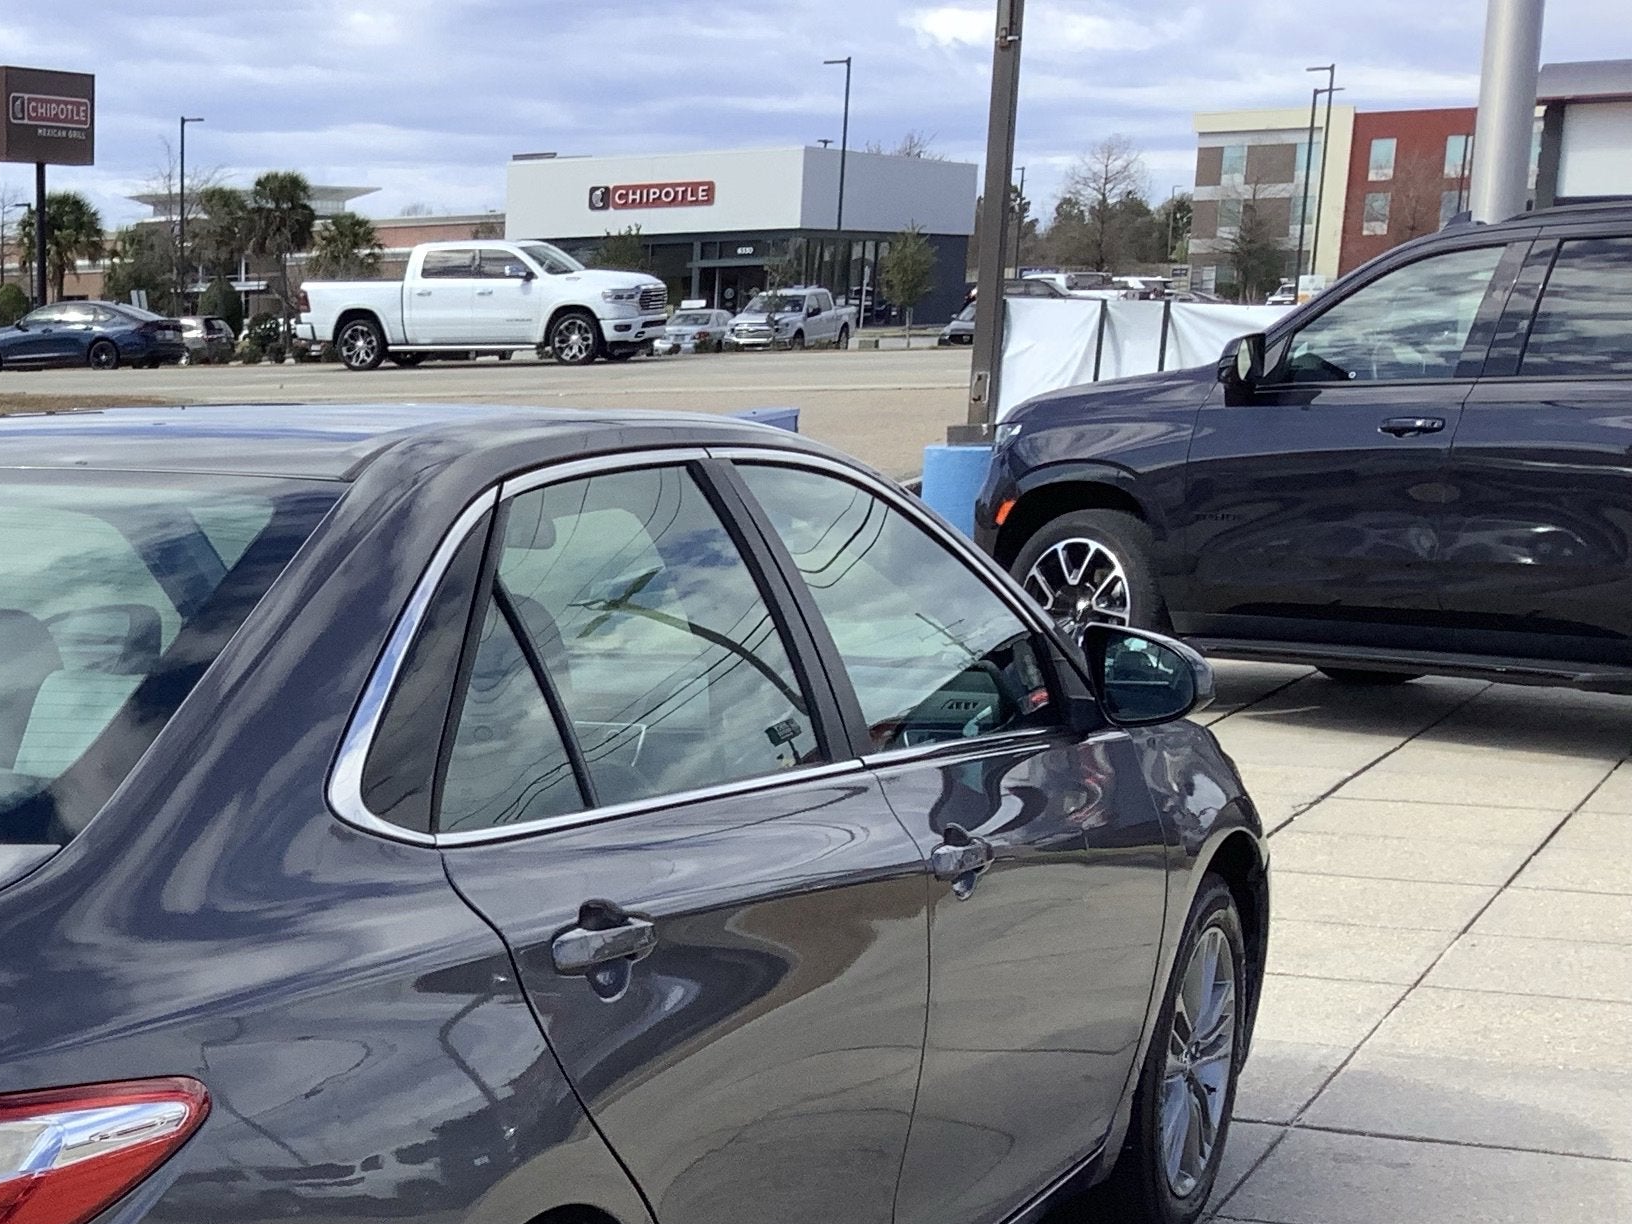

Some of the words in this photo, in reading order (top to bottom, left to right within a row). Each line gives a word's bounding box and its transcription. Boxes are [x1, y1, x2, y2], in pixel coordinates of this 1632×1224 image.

[29, 101, 86, 120] CHIPOTLE
[37, 128, 67, 138] MEXICAN
[68, 129, 86, 139] GRILL
[614, 185, 708, 204] CHIPOTLE
